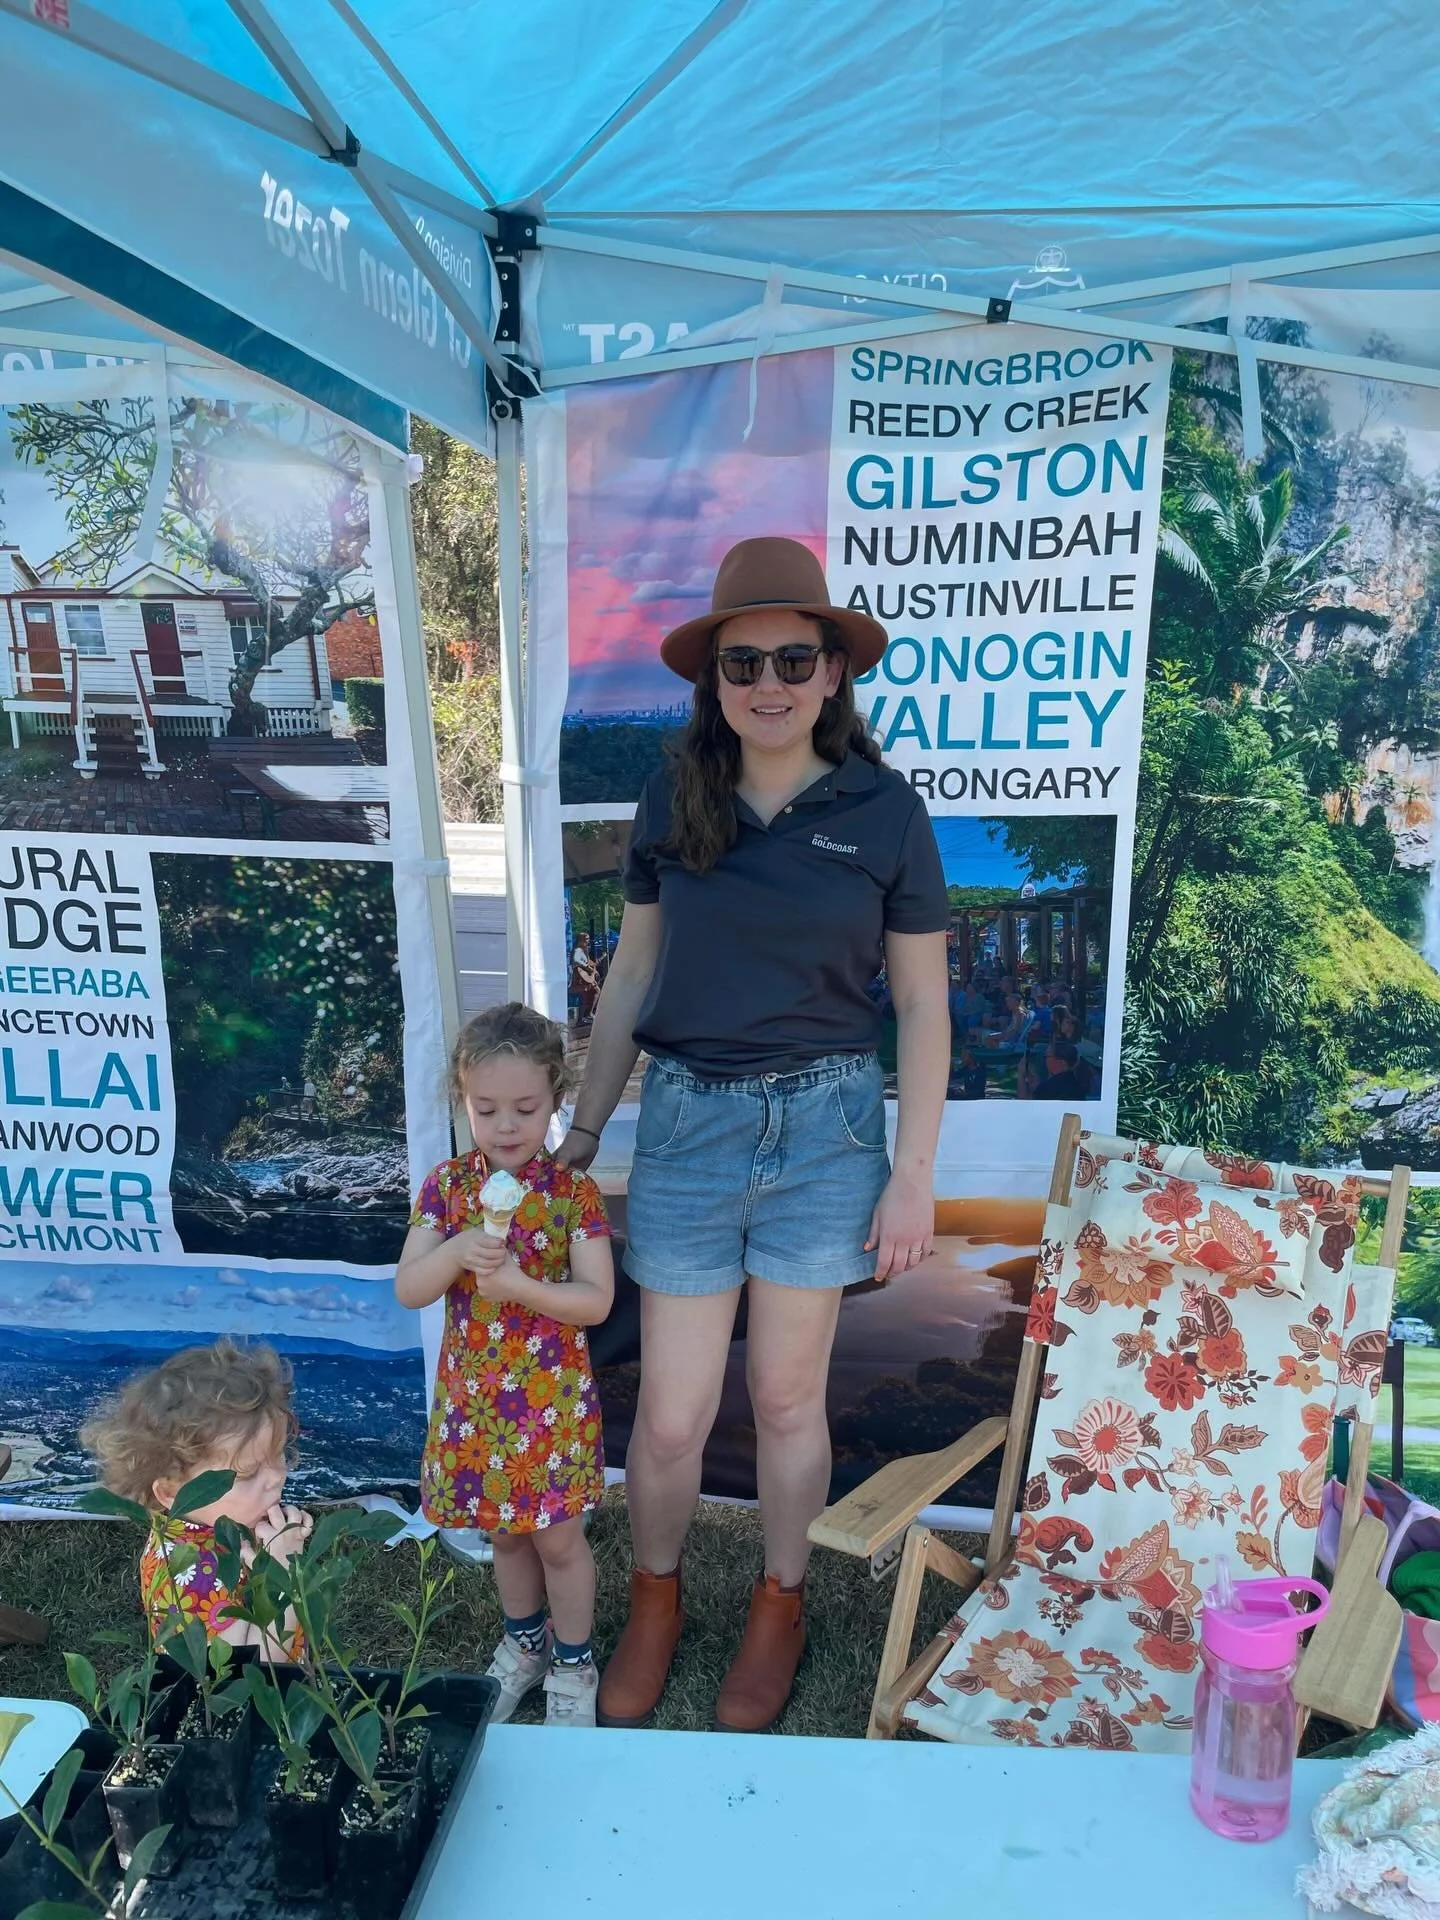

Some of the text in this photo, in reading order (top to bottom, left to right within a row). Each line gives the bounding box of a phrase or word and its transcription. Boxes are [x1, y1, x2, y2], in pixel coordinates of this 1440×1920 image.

[851, 340, 1154, 386] SPRINGBROOK
[849, 383, 1151, 437] REEDY CREEK
[846, 435, 1148, 510] GILSTON
[844, 510, 1142, 566] NUMINBAH
[846, 574, 1136, 620] AUSTINVILLE
[854, 630, 1132, 686] ONOGIN
[811, 838, 859, 855] GOLDCOAST
[2, 1047, 160, 1112] LLAI
